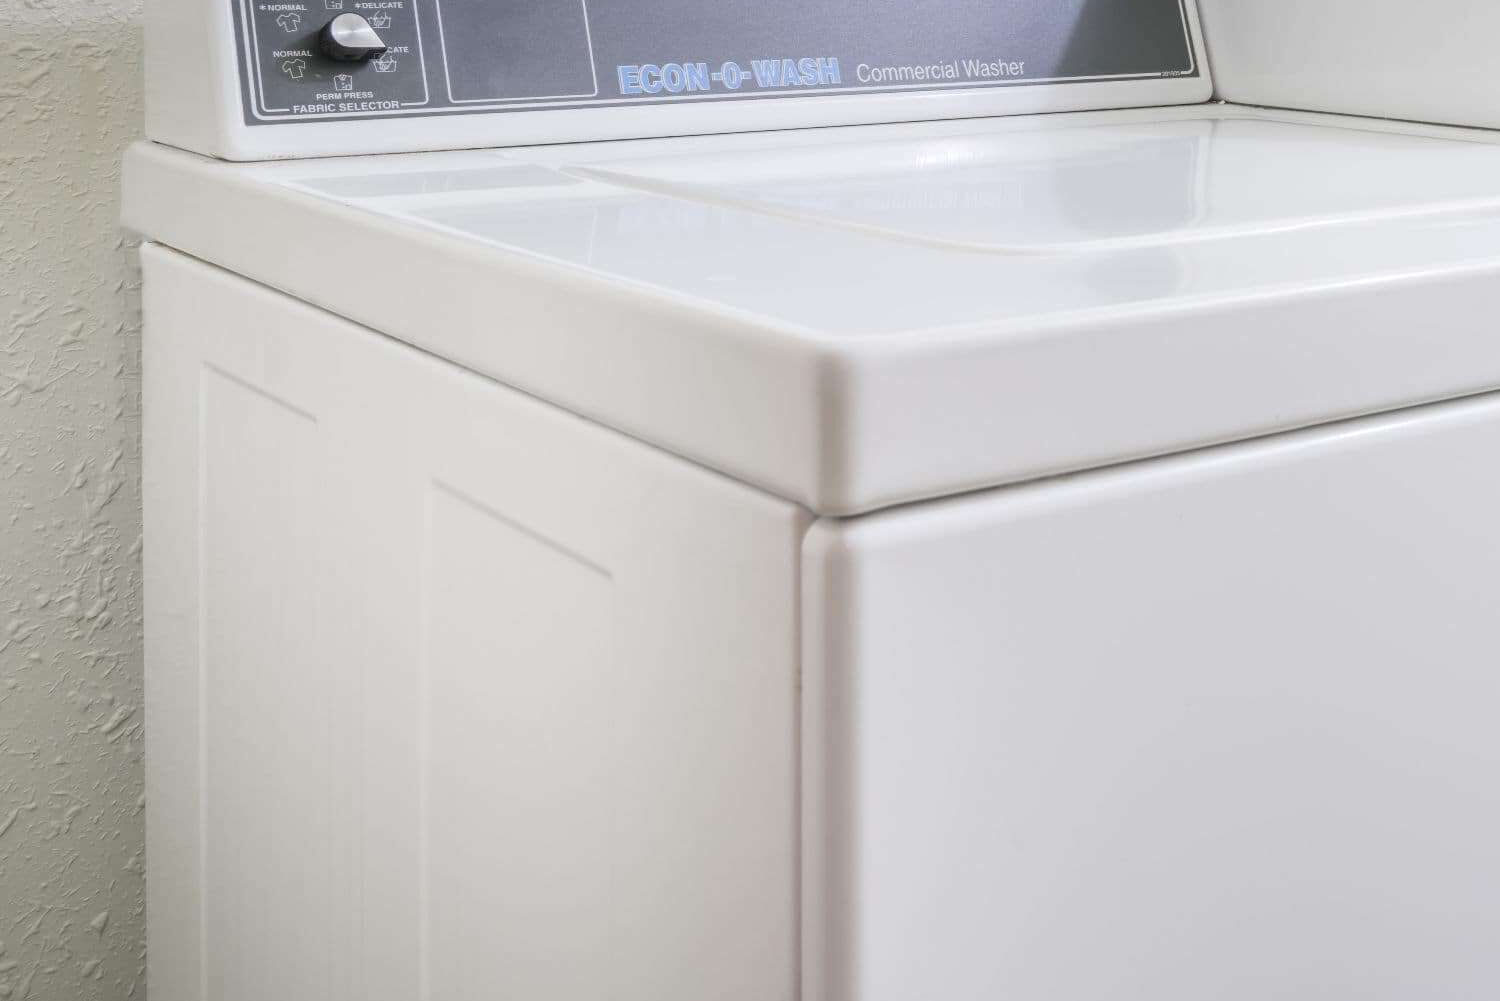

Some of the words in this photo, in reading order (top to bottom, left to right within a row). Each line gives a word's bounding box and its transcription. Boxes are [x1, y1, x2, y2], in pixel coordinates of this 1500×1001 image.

[361, 1, 404, 9] DELICATE
[272, 50, 313, 58] NORMAL
[387, 46, 409, 54] CATE
[616, 57, 841, 95] ECON-O-WASH
[856, 60, 960, 83] Commercial
[962, 59, 1025, 77] Washer
[344, 91, 374, 99] PRESS
[293, 104, 337, 113] FABRIC
[339, 101, 400, 112] SELECTOR
